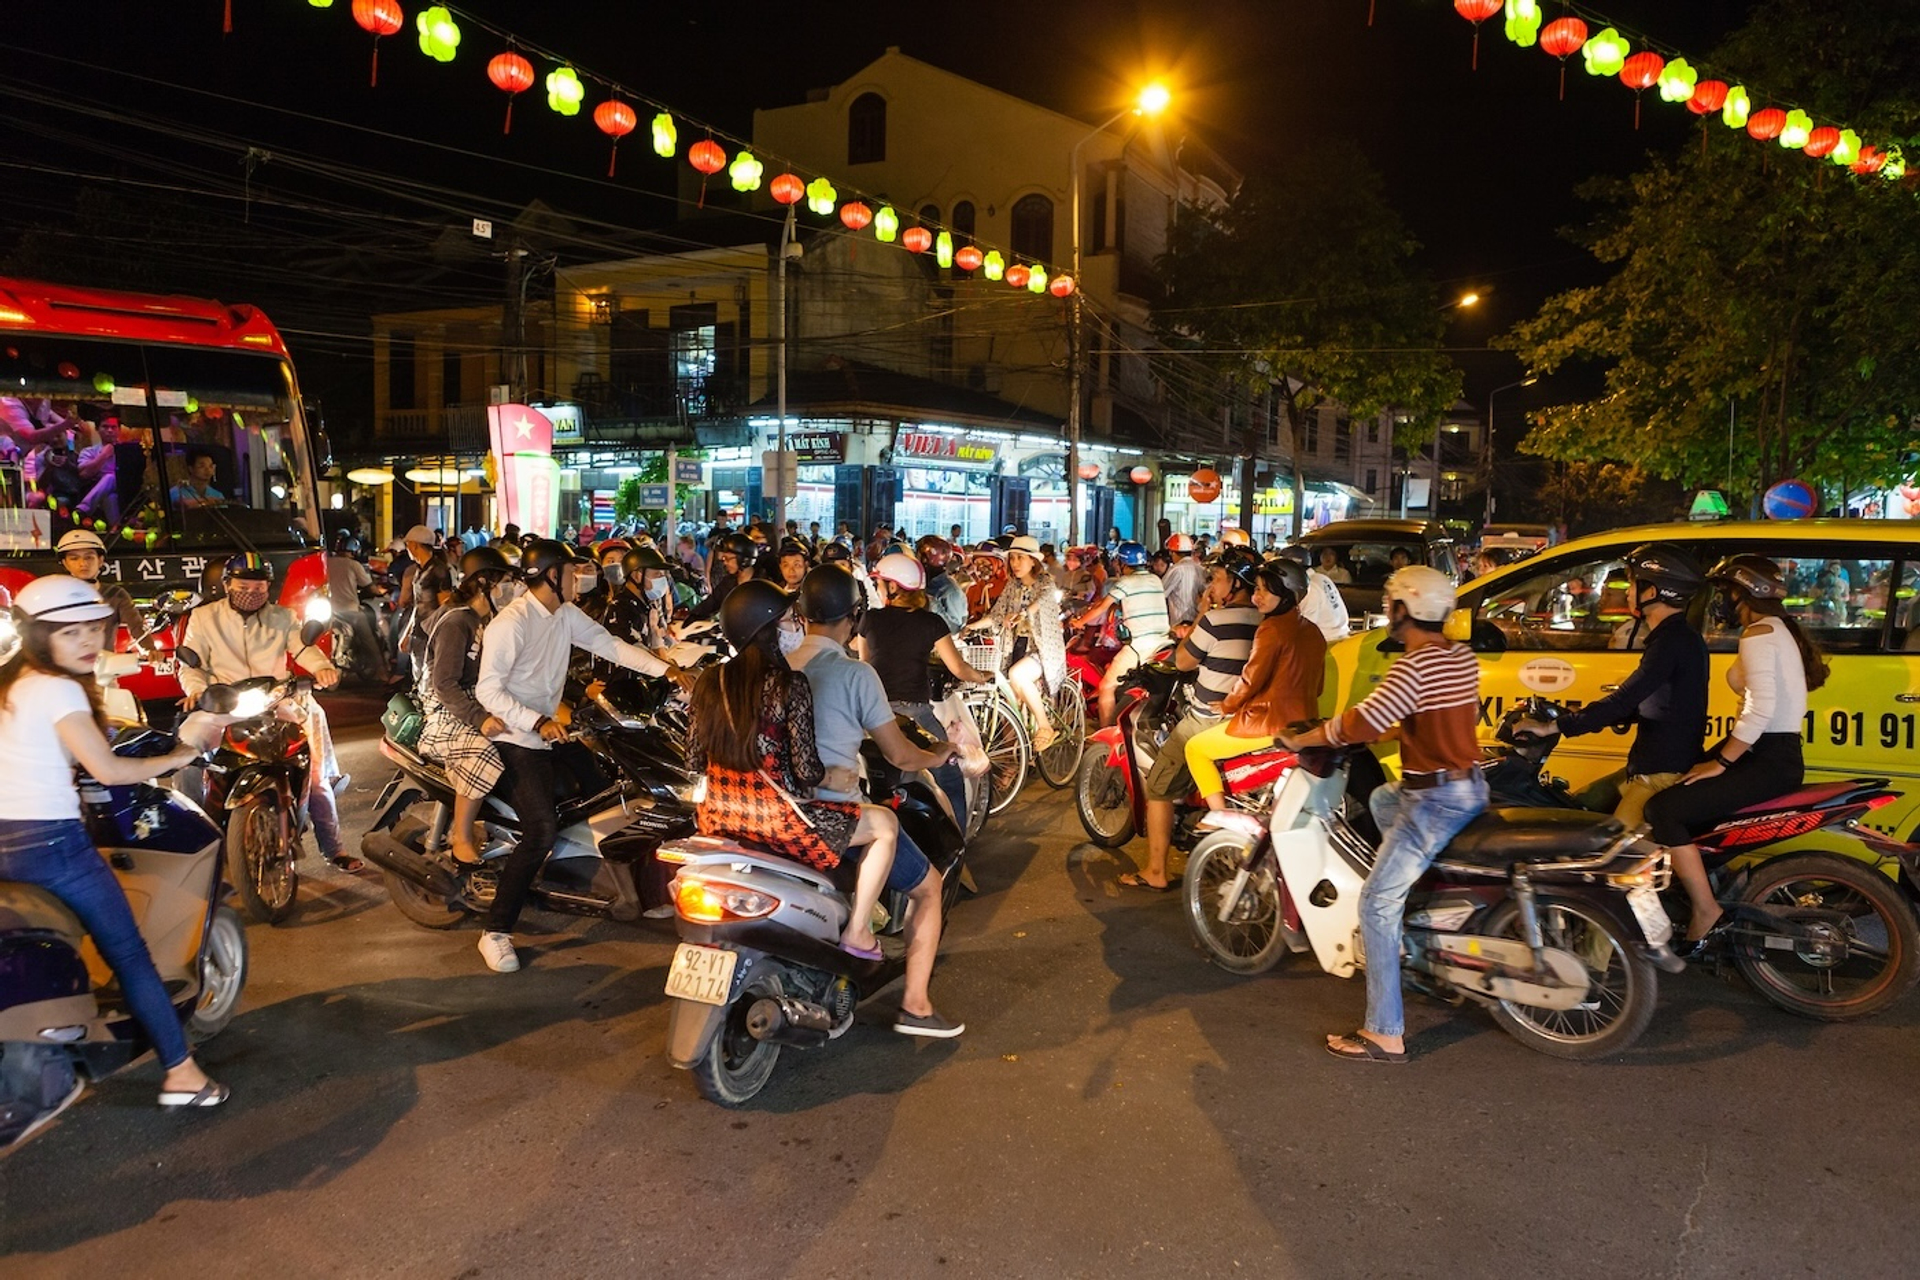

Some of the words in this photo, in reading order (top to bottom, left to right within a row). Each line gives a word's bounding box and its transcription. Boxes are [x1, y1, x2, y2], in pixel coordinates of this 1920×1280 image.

[1830, 711, 1864, 747] 91
[1880, 713, 1915, 749] 91
[639, 820, 669, 830] HONDA
